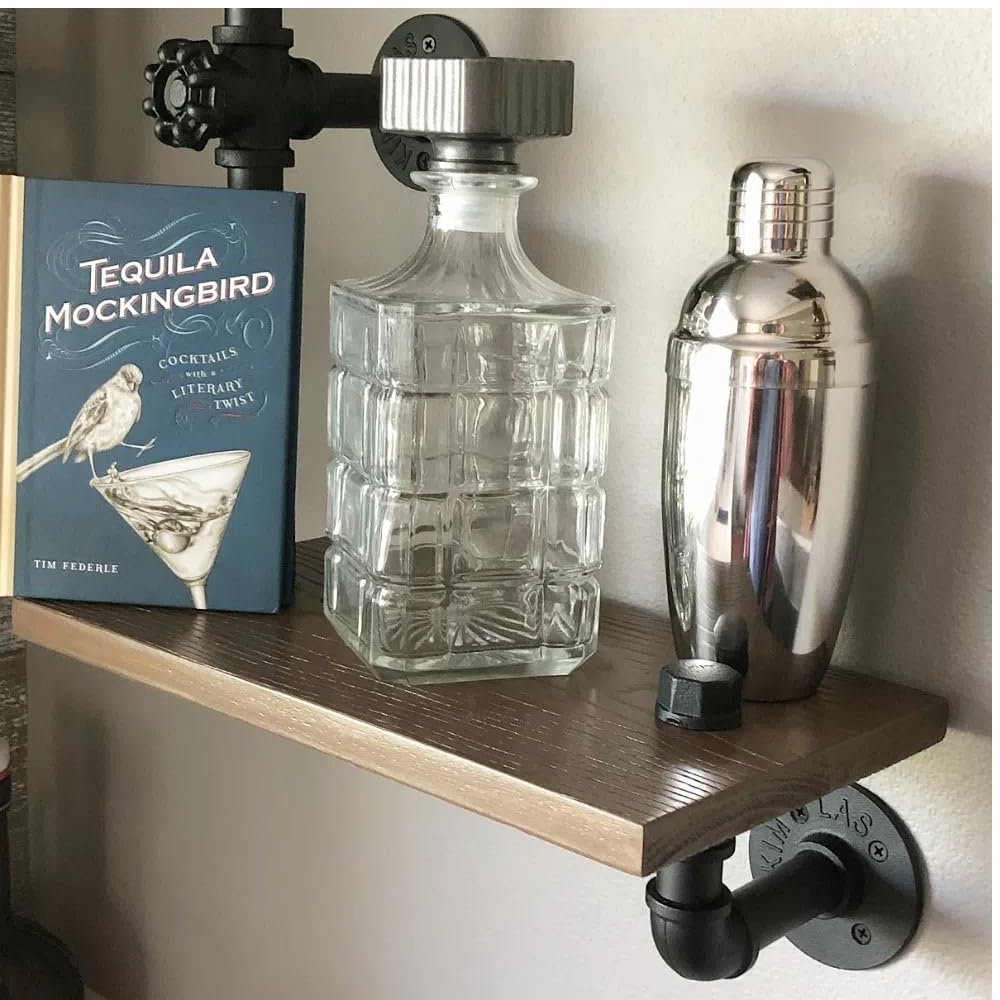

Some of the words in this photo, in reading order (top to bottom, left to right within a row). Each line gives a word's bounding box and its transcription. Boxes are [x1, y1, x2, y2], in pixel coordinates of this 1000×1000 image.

[79, 246, 219, 295] TEQUILA
[44, 271, 275, 334] MOCKINGBIRD
[159, 346, 238, 369] COCKTAILS
[185, 370, 207, 379] with
[171, 378, 243, 400] LITERARY
[214, 391, 255, 410] TWIST
[33, 559, 57, 570] TIM
[62, 561, 119, 574] FEDERLE
